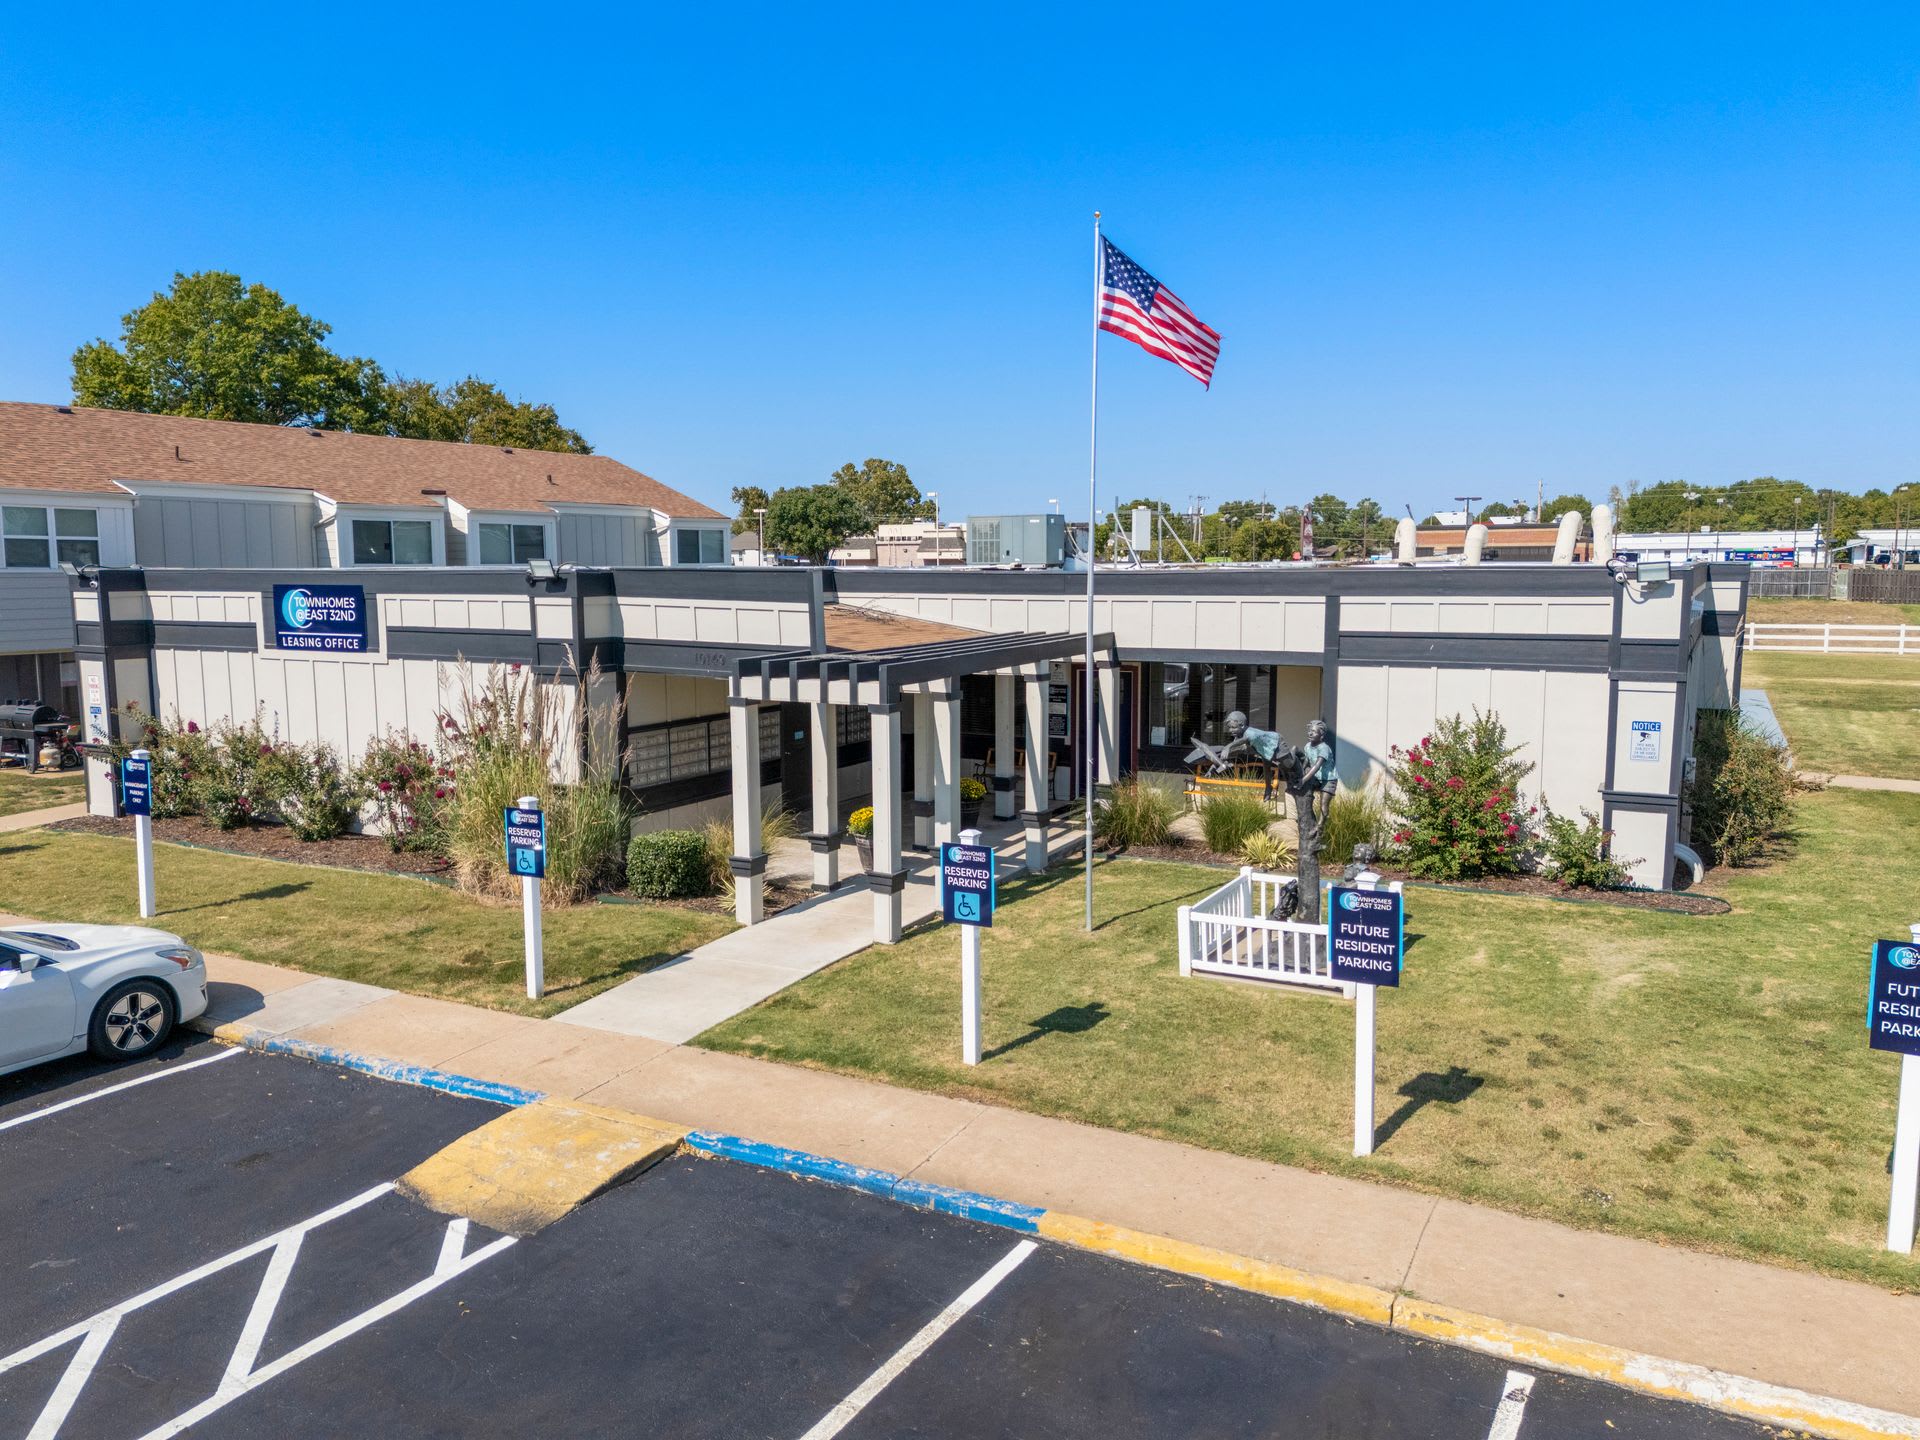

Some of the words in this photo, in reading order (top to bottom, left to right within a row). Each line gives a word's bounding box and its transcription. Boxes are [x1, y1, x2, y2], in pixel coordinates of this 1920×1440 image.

[294, 597, 355, 608] TOWNHOMES
[296, 609, 328, 621] @EAST
[330, 610, 356, 621] 32ND
[282, 637, 322, 647] LEASING
[324, 638, 359, 648] OFFICE
[1633, 722, 1660, 730] NOTICE
[508, 827, 541, 838] RESERVED
[511, 836, 539, 846] PARKING
[944, 866, 990, 879] RESERVED
[948, 876, 986, 889] PARKING
[1349, 895, 1392, 905] TOWNHOMES
[1373, 903, 1392, 911] 32ND
[1341, 923, 1390, 938] FUTURE
[1335, 939, 1395, 955] RESIDENT
[1338, 956, 1392, 972] PARKING
[1888, 983, 1920, 998] FUT
[1881, 1021, 1920, 1037] PARK
